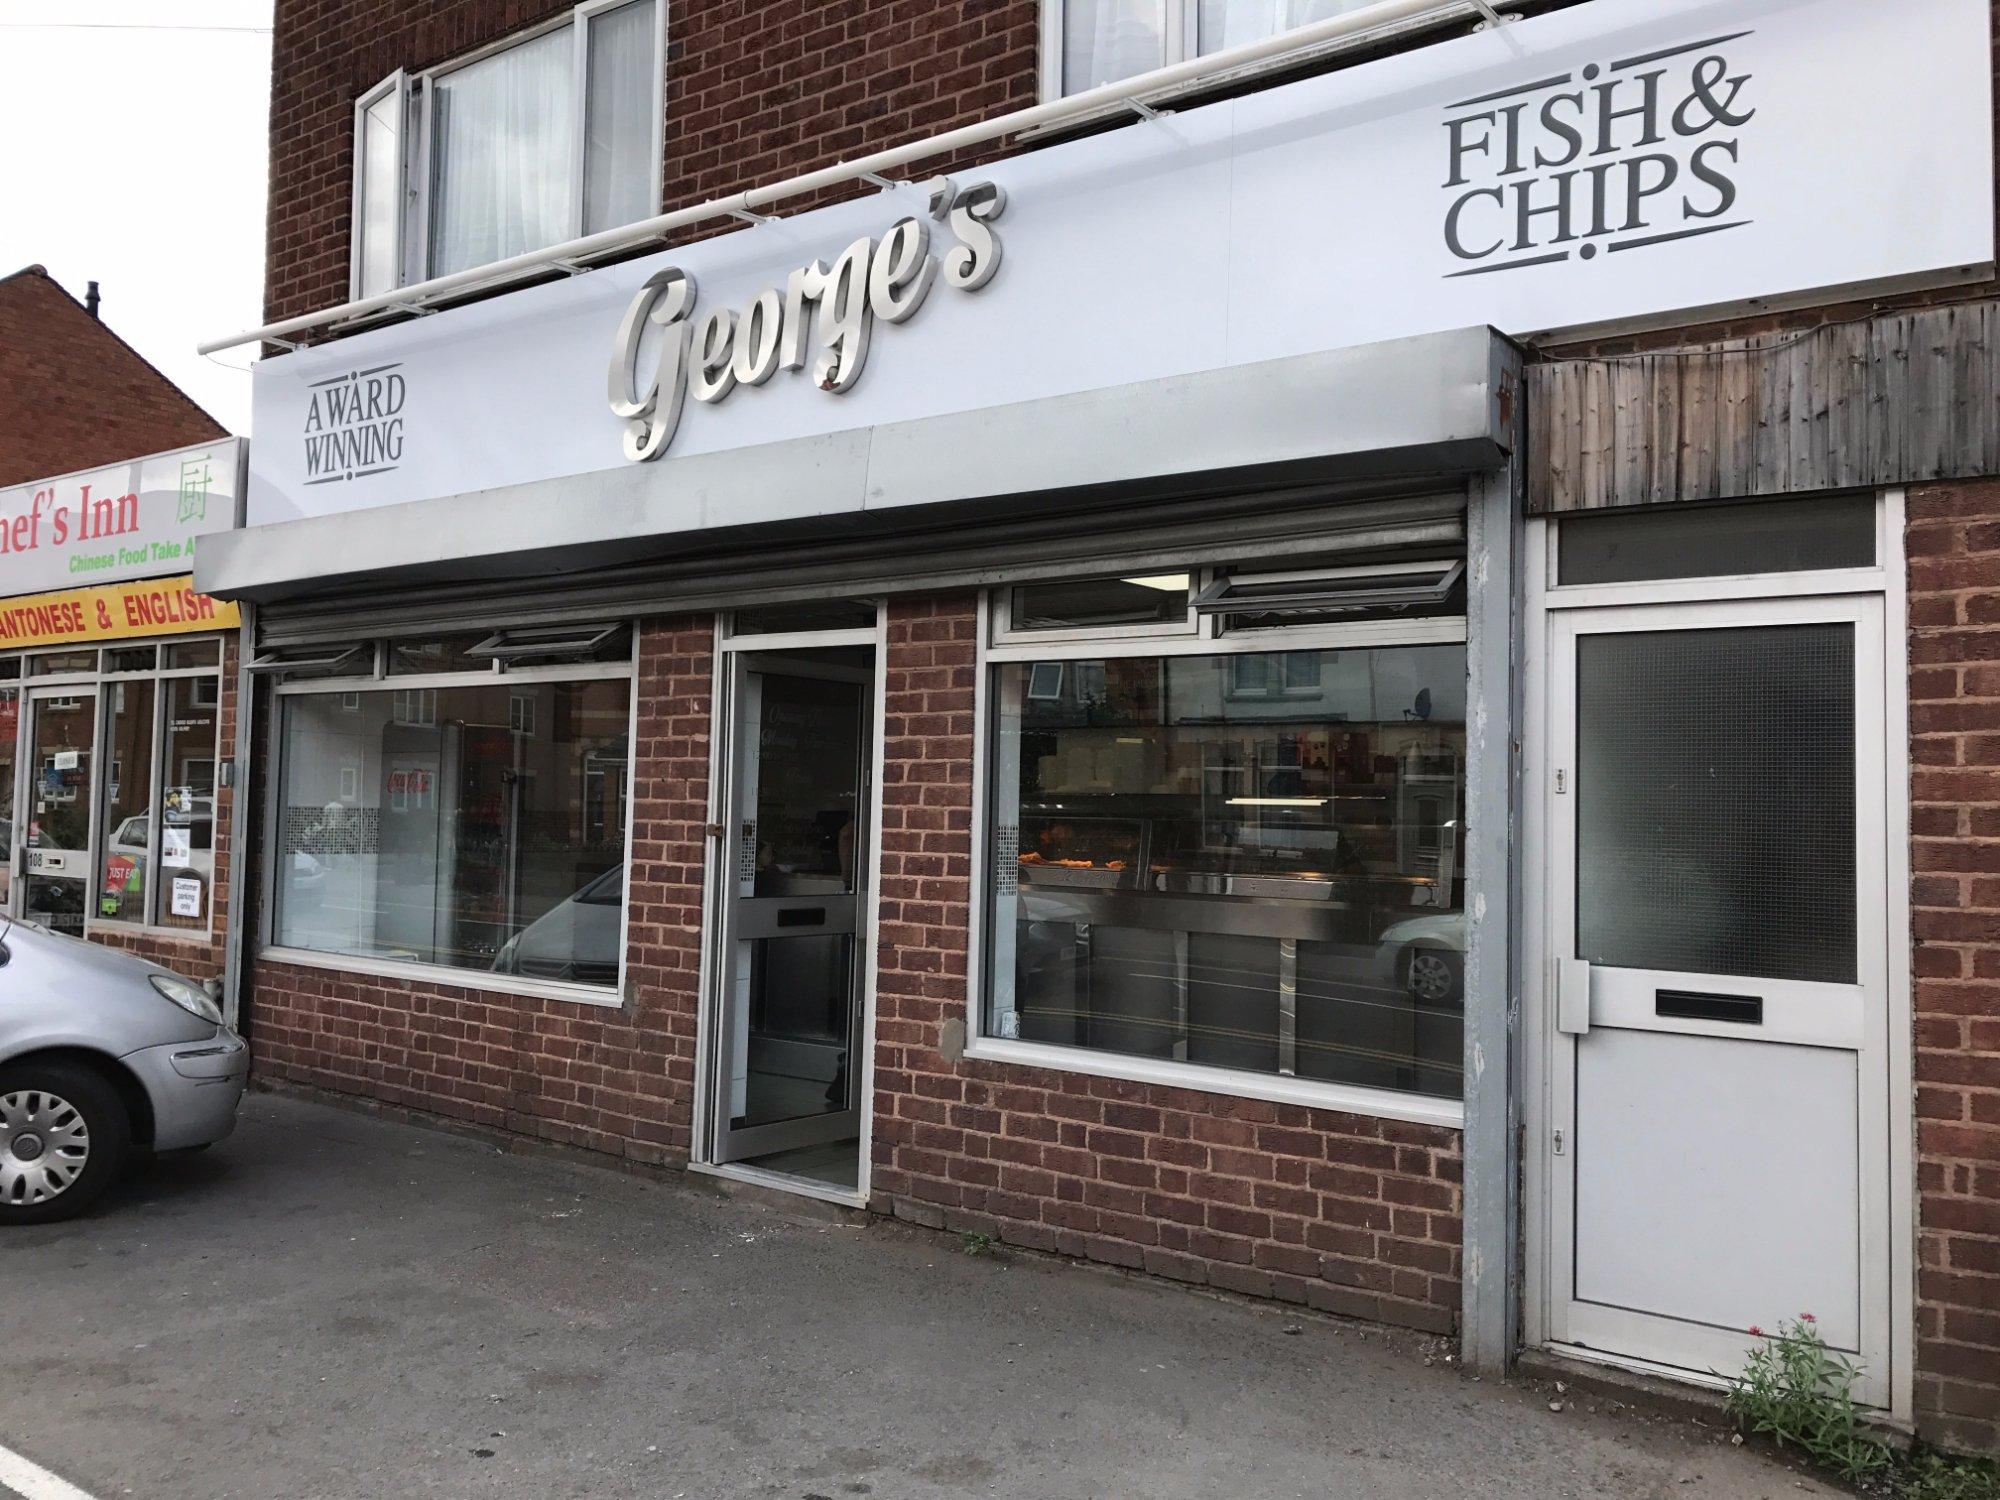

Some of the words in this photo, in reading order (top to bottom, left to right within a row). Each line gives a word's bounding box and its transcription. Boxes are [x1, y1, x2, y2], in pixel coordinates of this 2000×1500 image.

[1444, 138, 1738, 259] CHIPS
[608, 174, 1008, 462] George's
[304, 373, 406, 433] AWARD
[304, 418, 404, 476] WINNING
[77, 484, 140, 541] Inn
[69, 553, 115, 573] Chinese
[118, 543, 148, 566] Food
[150, 540, 182, 560] Take
[96, 598, 113, 630] &
[123, 587, 215, 627] ENGLISH
[29, 853, 43, 867] 108
[109, 867, 125, 880] JUST
[176, 881, 198, 891] Customer
[177, 892, 195, 903] parking
[180, 903, 191, 912] only
